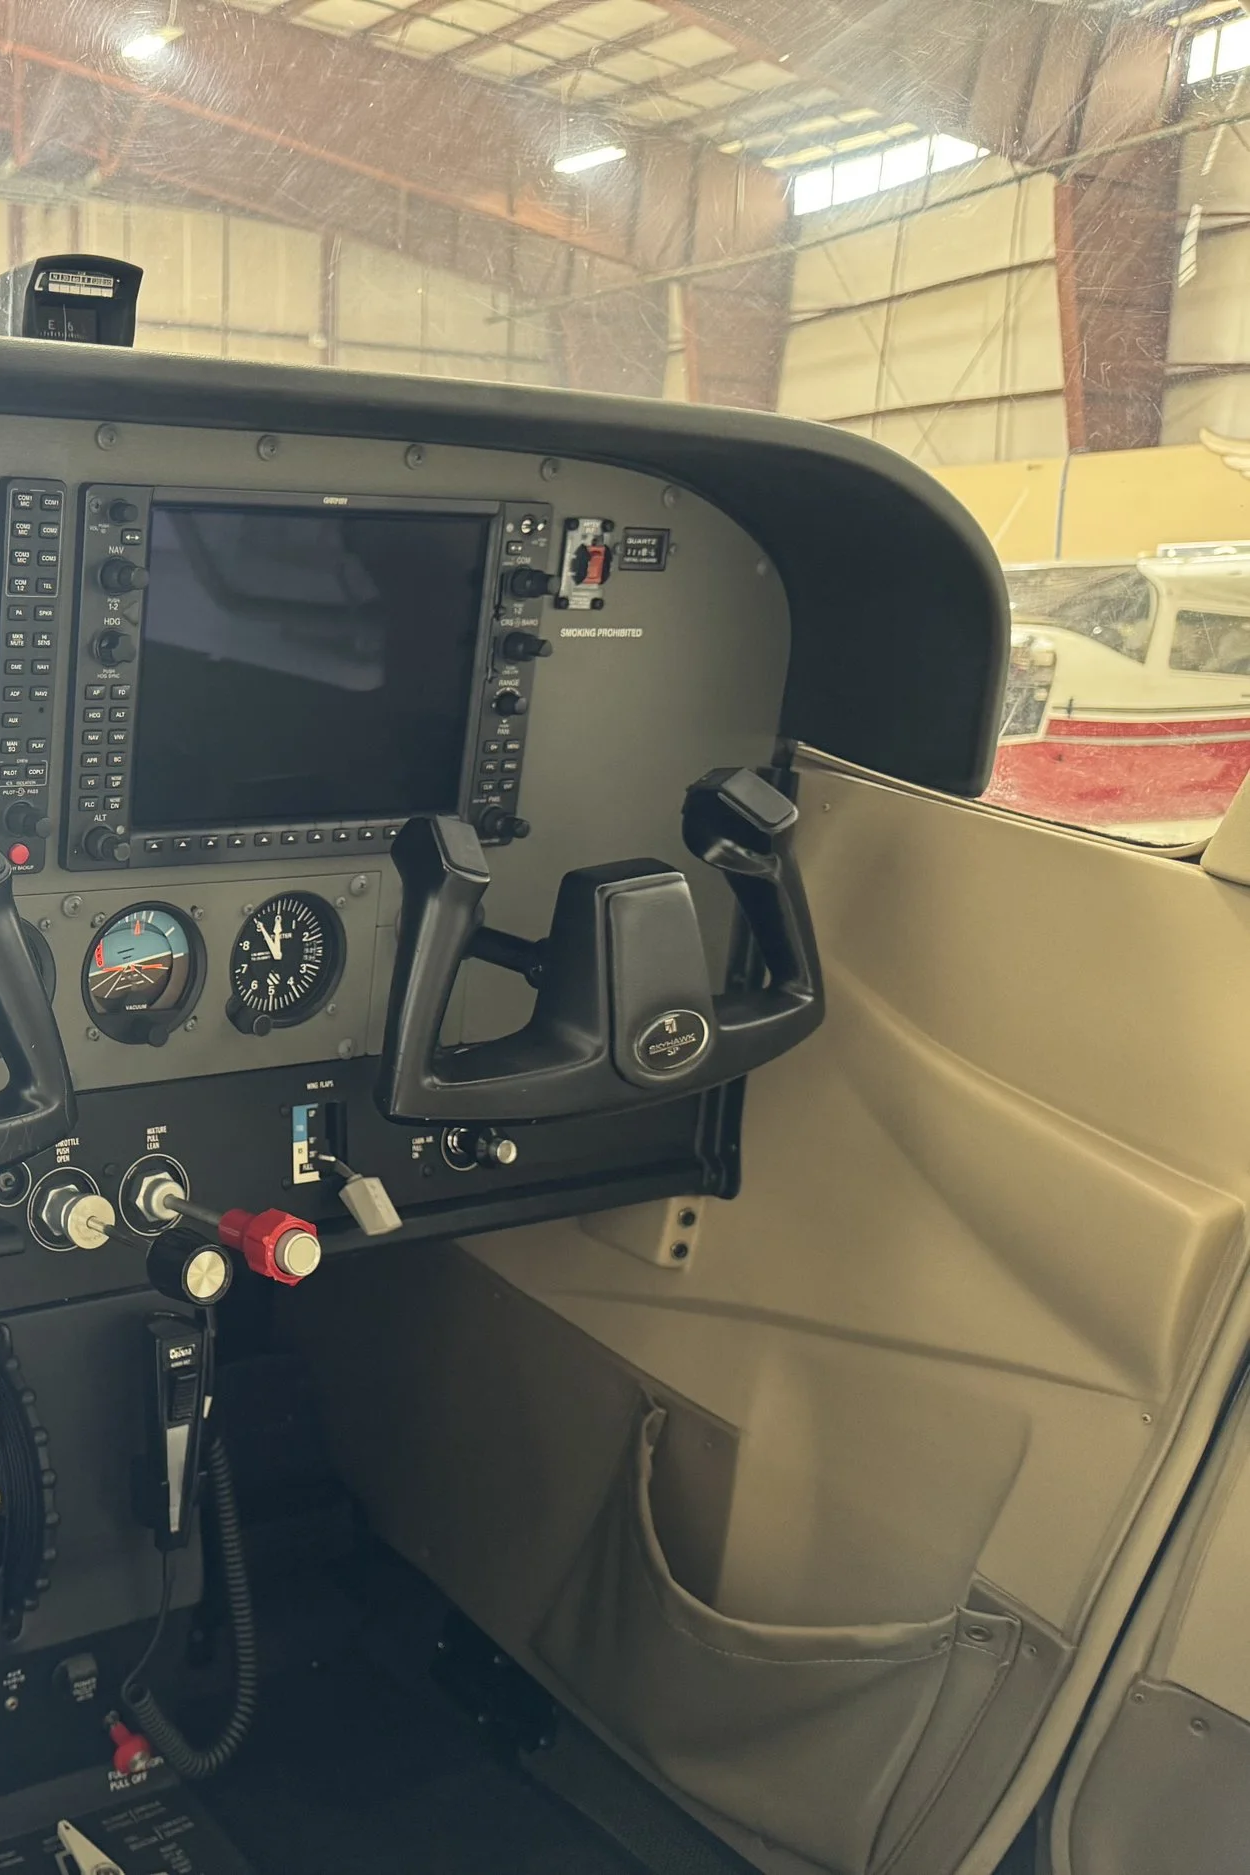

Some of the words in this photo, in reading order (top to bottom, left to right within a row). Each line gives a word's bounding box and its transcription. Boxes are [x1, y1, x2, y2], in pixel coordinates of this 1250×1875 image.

[48, 320, 54, 329] E
[109, 546, 124, 554] NAV
[561, 628, 596, 638] SMOKING
[597, 628, 642, 637] PROHIBITED
[649, 1034, 695, 1051] SKYHAWK
[668, 1047, 680, 1056] SP
[147, 1142, 159, 1150] LEAN
[56, 1155, 70, 1163] OPEN
[110, 1779, 130, 1792] PULL
[131, 1772, 148, 1784] OFF
